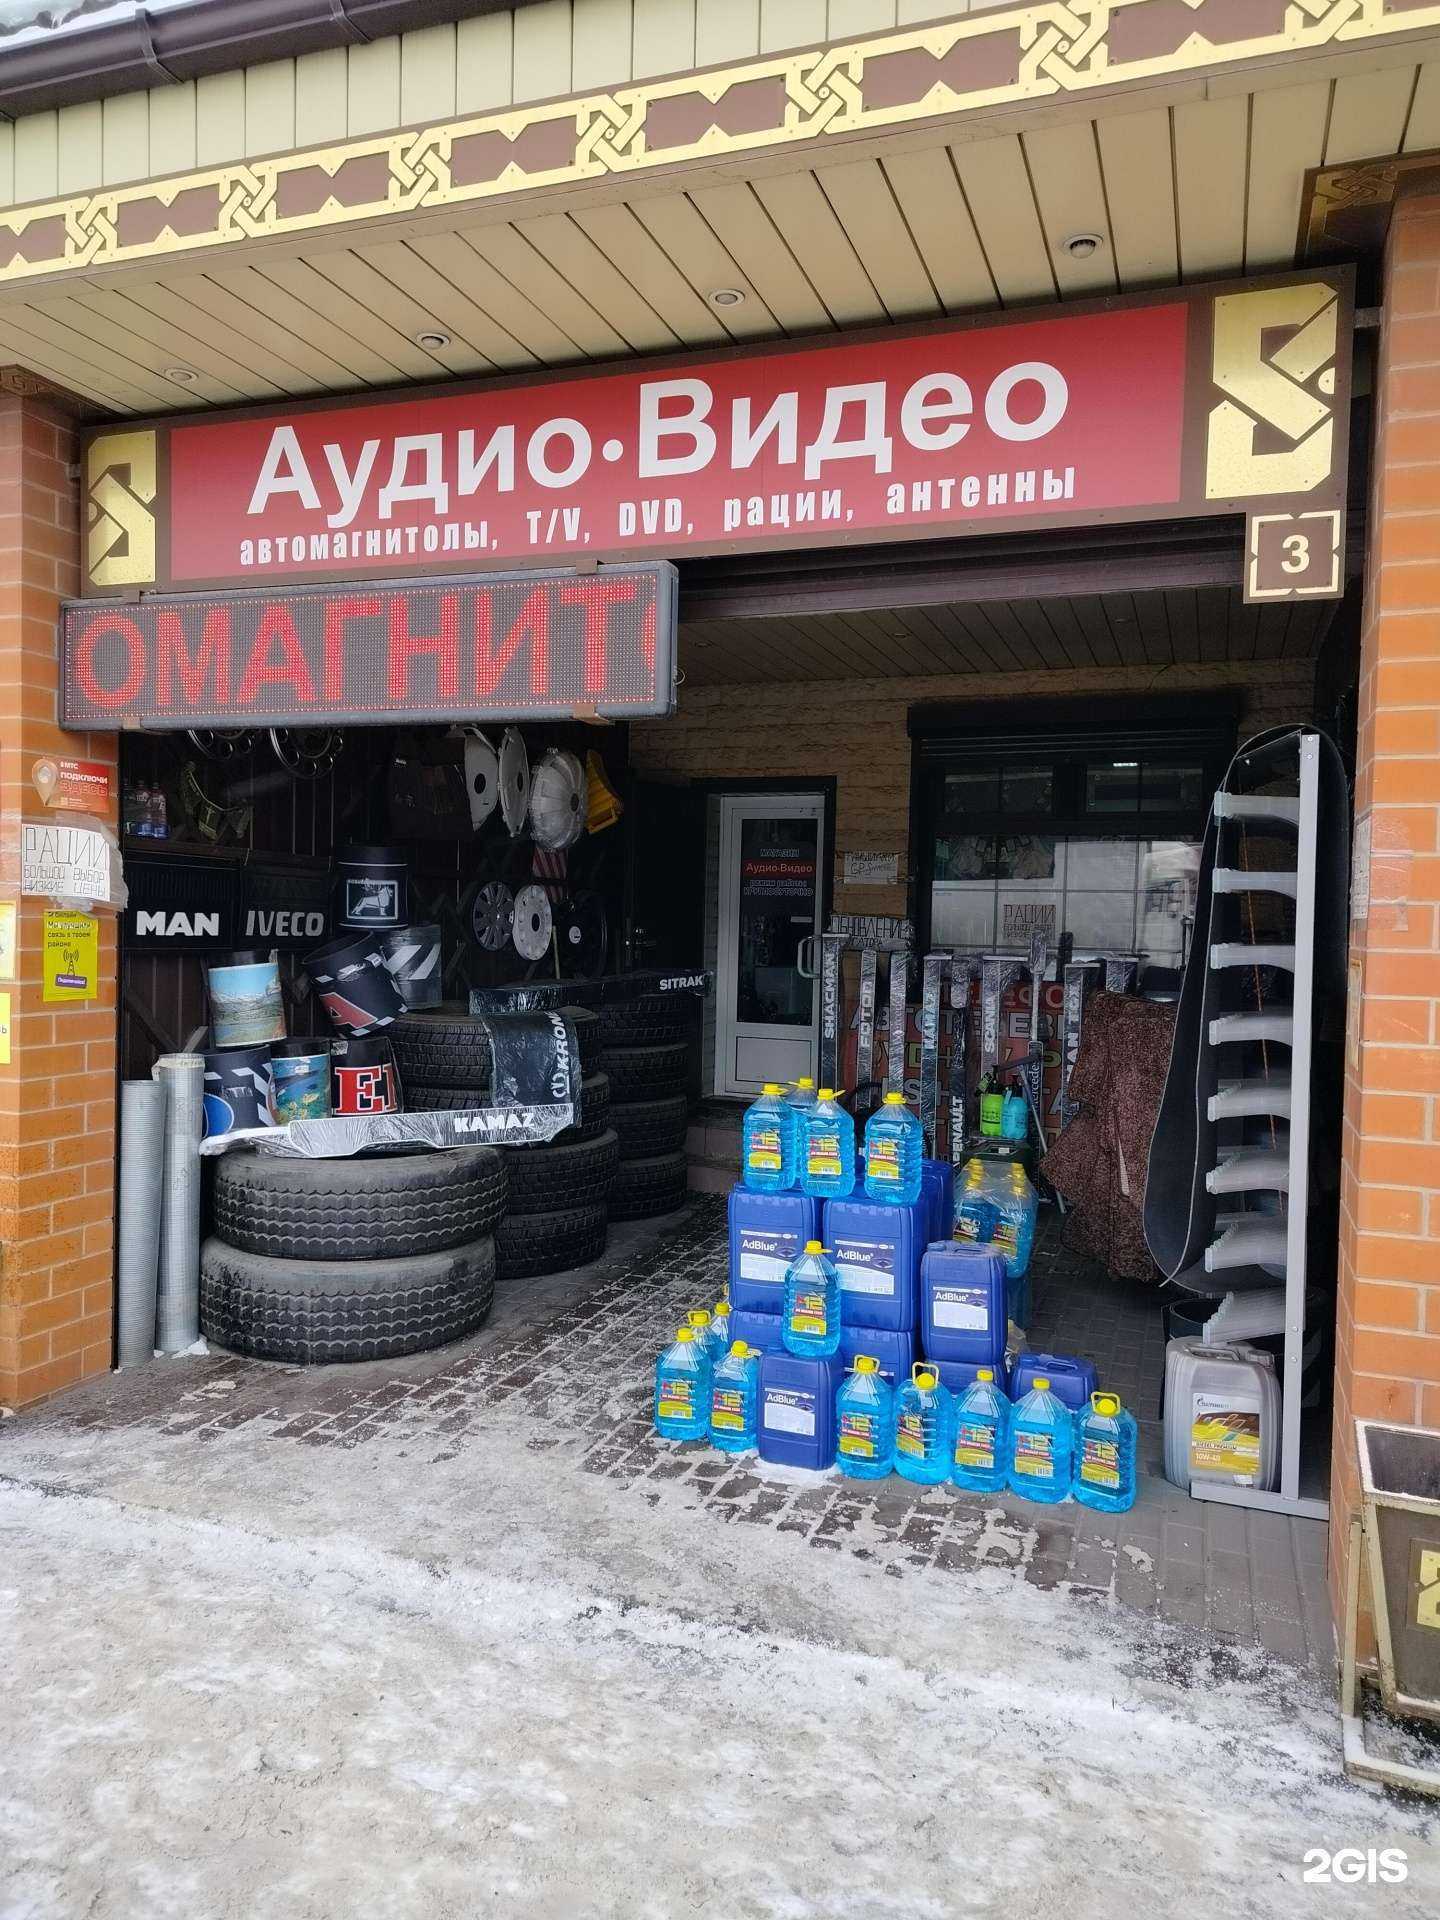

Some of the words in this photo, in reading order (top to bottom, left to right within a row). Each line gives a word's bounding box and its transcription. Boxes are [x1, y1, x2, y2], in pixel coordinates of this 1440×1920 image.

[239, 520, 499, 566] автомагнитолы,
[526, 507, 590, 545] T/V,
[618, 497, 694, 537] DVD,
[723, 486, 856, 533] рации,
[885, 466, 1077, 515] антенны
[1281, 534, 1311, 574] 3
[25, 827, 107, 868] РАЦИИ
[136, 910, 220, 937] MAN
[245, 910, 325, 937] IVECO
[659, 975, 704, 991] SITRAK
[824, 951, 836, 1040] SHACMAN
[454, 1112, 535, 1133] KAMAZ
[742, 1239, 776, 1252] AdBlue
[836, 1249, 872, 1263] AdBlue
[935, 1291, 967, 1302] AdBlue
